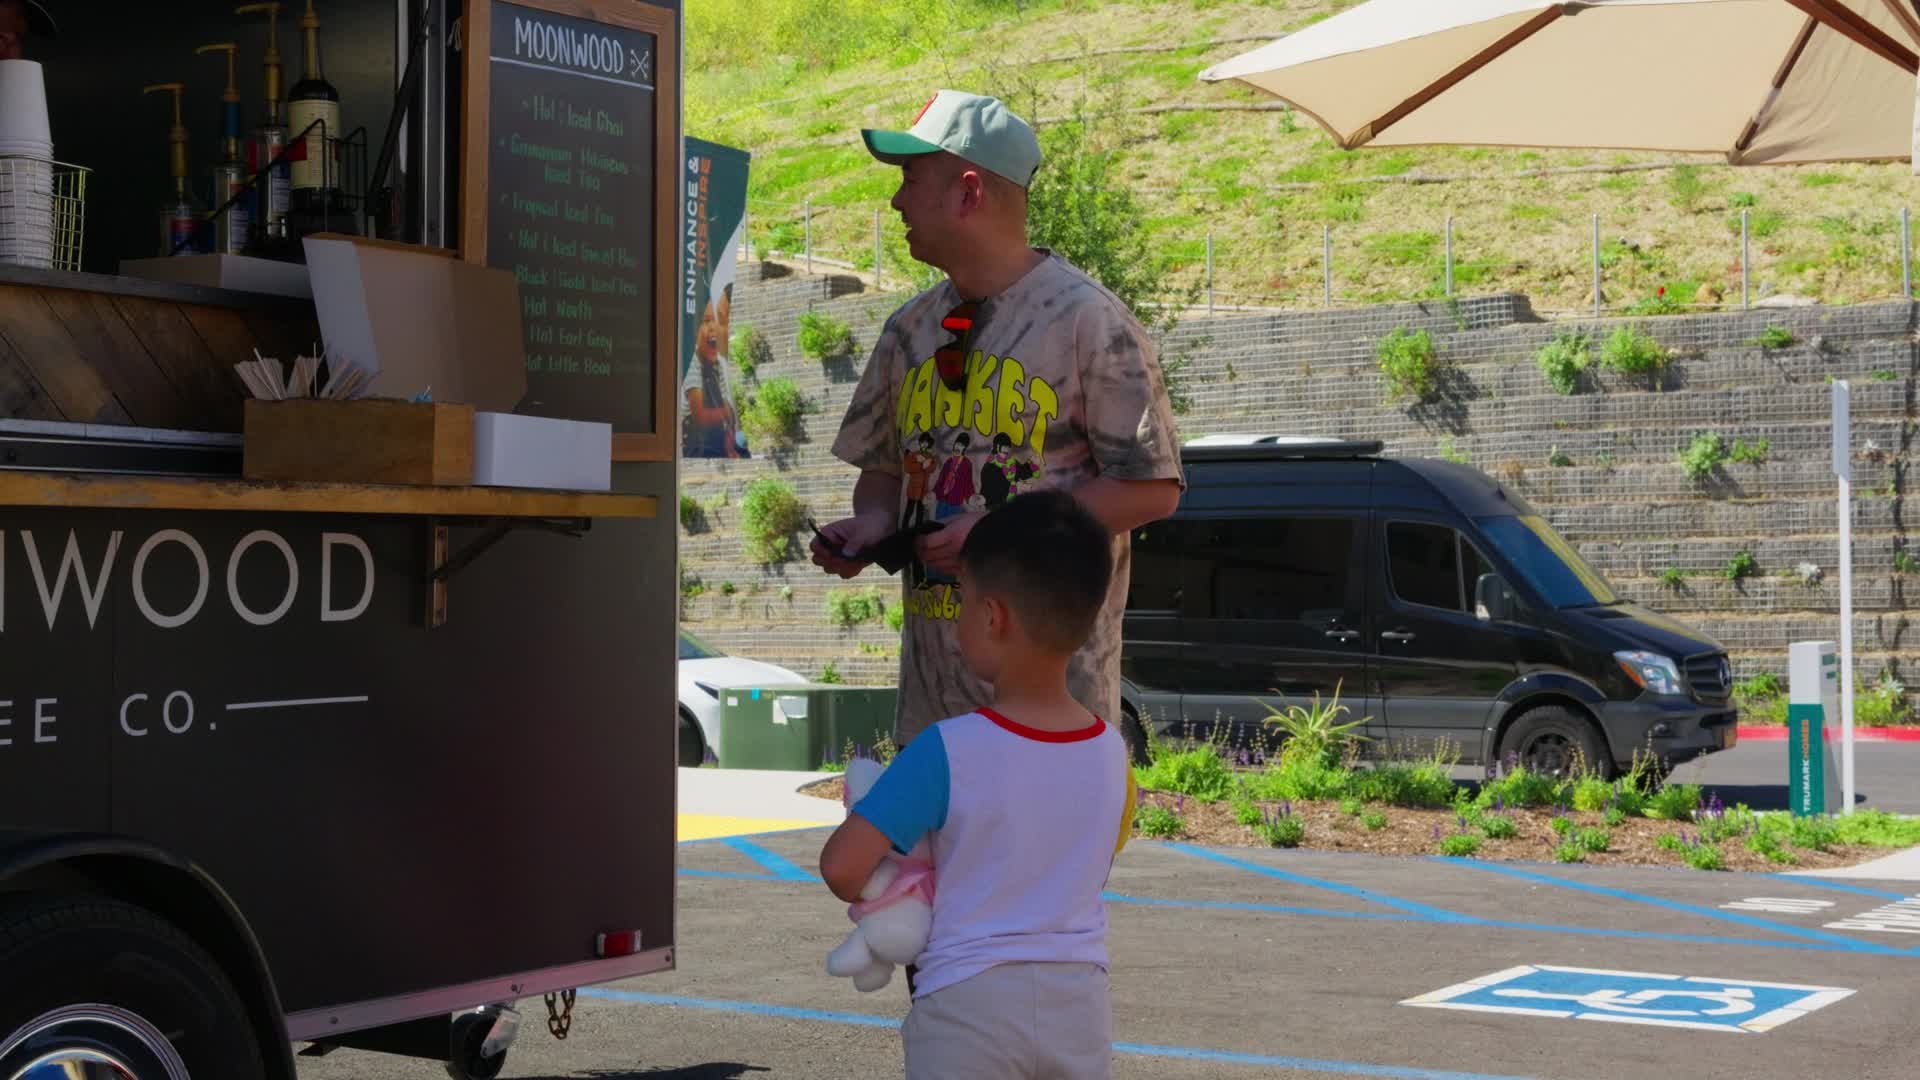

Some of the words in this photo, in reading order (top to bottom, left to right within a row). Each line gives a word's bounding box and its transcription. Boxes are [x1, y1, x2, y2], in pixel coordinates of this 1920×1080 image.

[514, 16, 624, 74] MOONWOOD
[688, 156, 700, 174] &
[686, 181, 699, 314] ENHANCE
[697, 159, 712, 267] INSPIRE
[0, 527, 375, 633] WOOD
[119, 690, 217, 737] CO.
